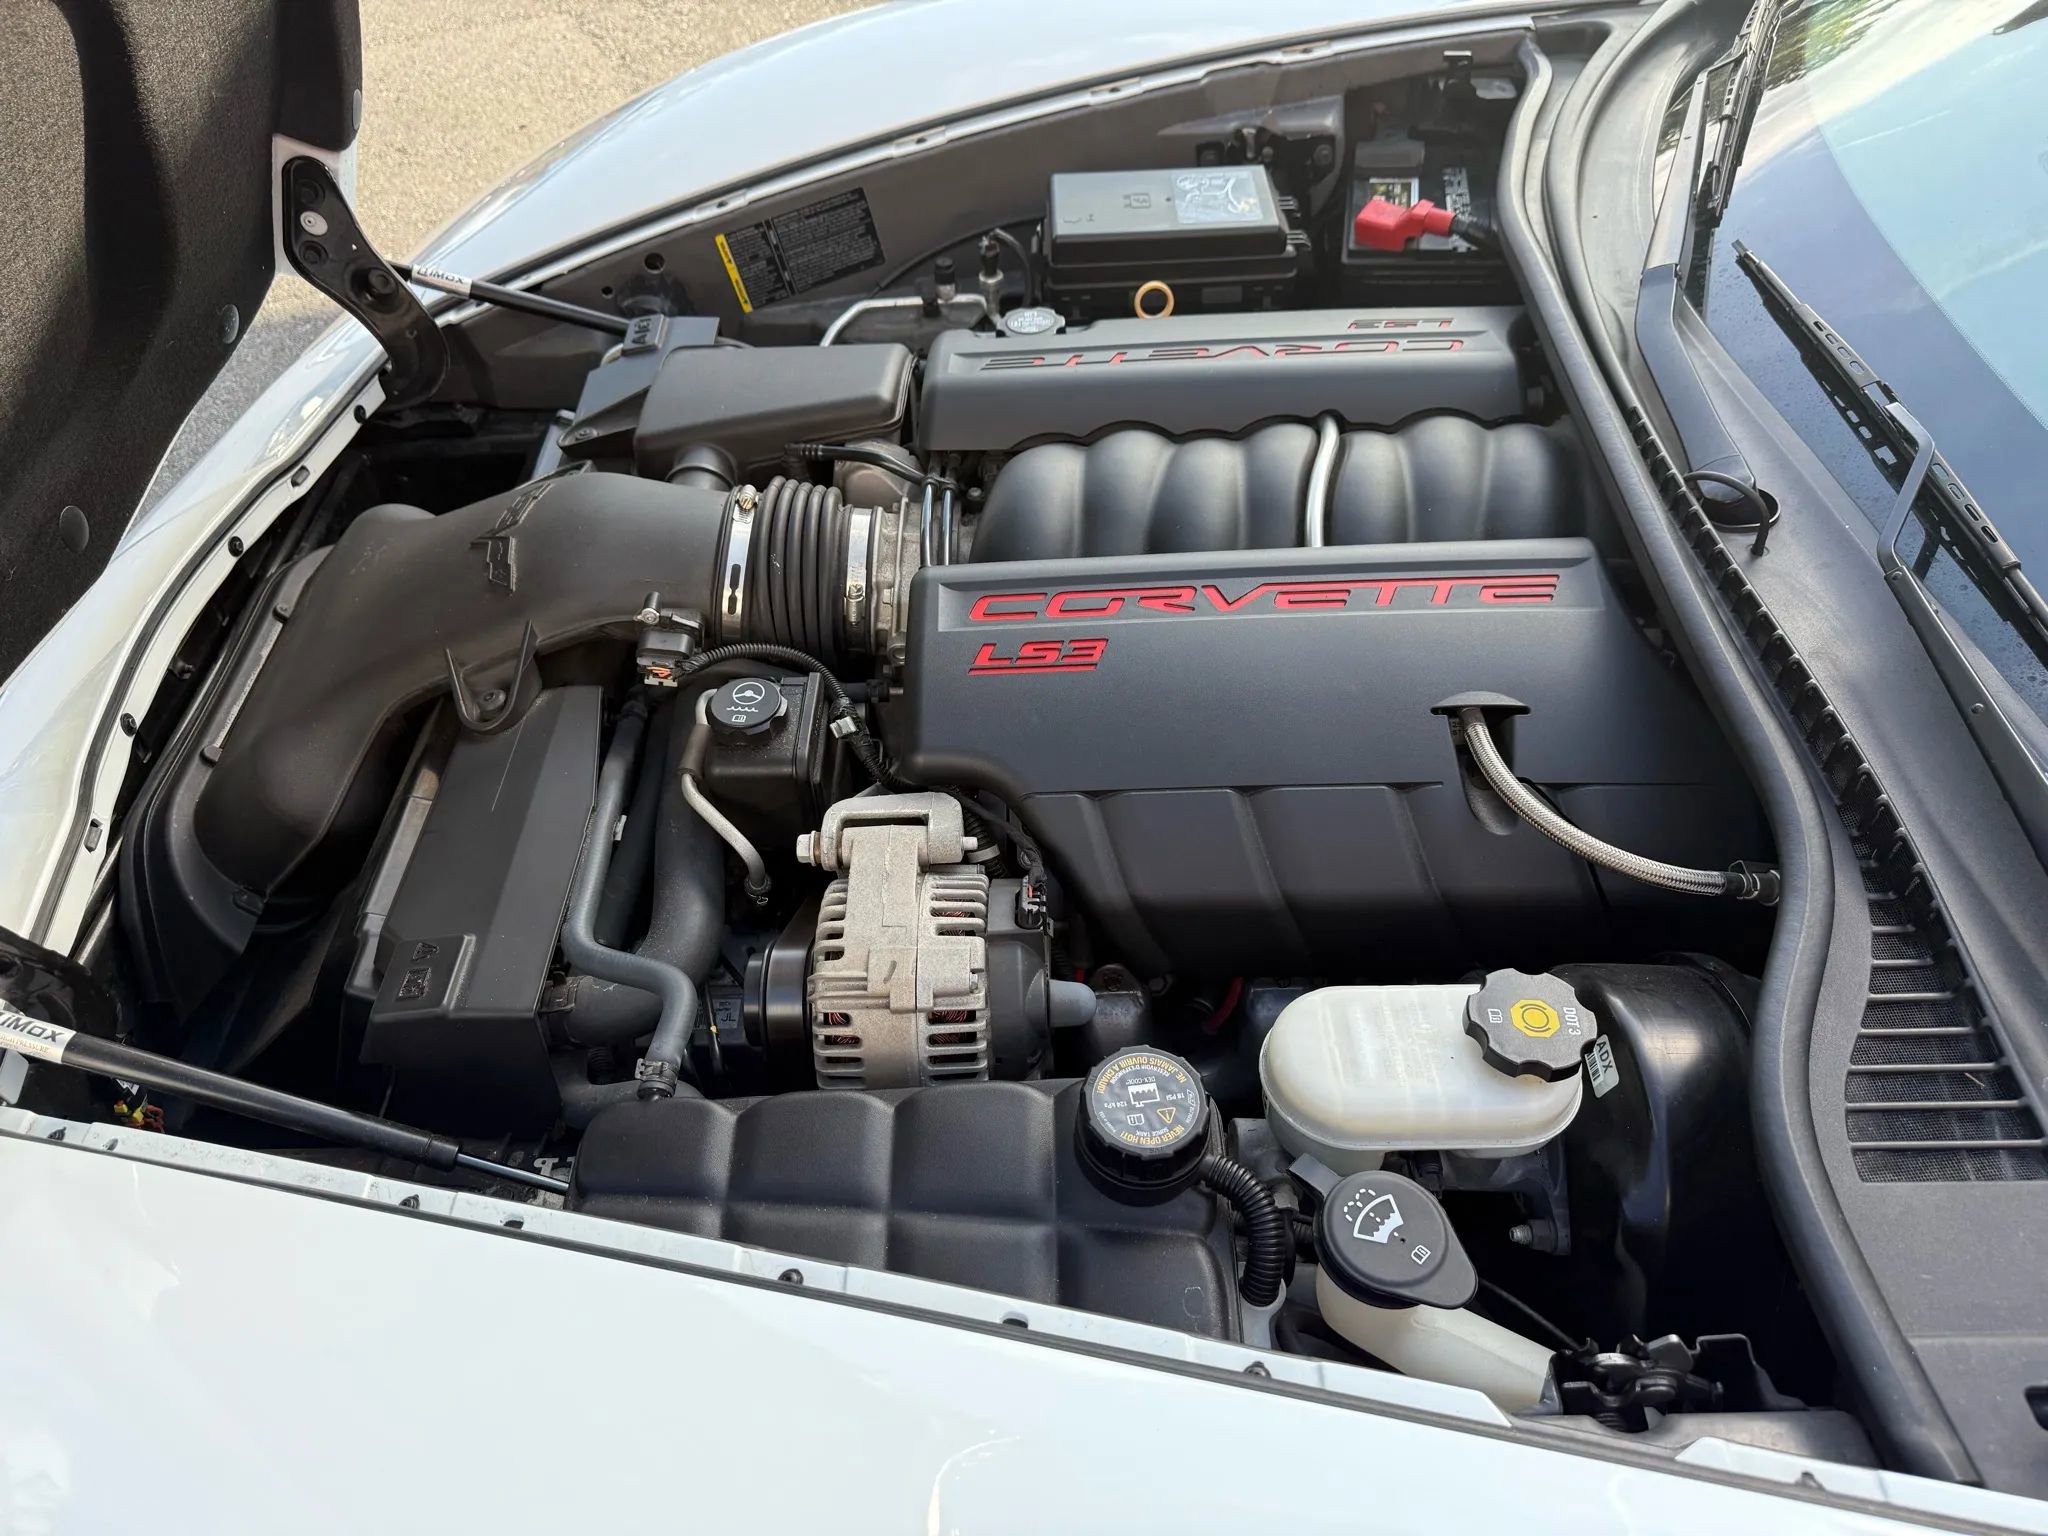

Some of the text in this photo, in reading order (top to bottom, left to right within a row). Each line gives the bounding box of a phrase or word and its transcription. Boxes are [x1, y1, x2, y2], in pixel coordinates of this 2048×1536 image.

[980, 339, 1464, 371] CORVETTE
[968, 575, 1560, 622] CORVETTE
[970, 638, 1108, 668] LS3
[1563, 1006, 1581, 1036] DOT 3
[1119, 1056, 1148, 1068] OUVRIR
[1149, 1057, 1178, 1073] JAMAIS
[1596, 1041, 1613, 1074] ADX
[1097, 1069, 1118, 1094] CHAUD!
[1175, 1073, 1187, 1083] NE
[1119, 1124, 1185, 1145] NEVER OPEN HOT!
